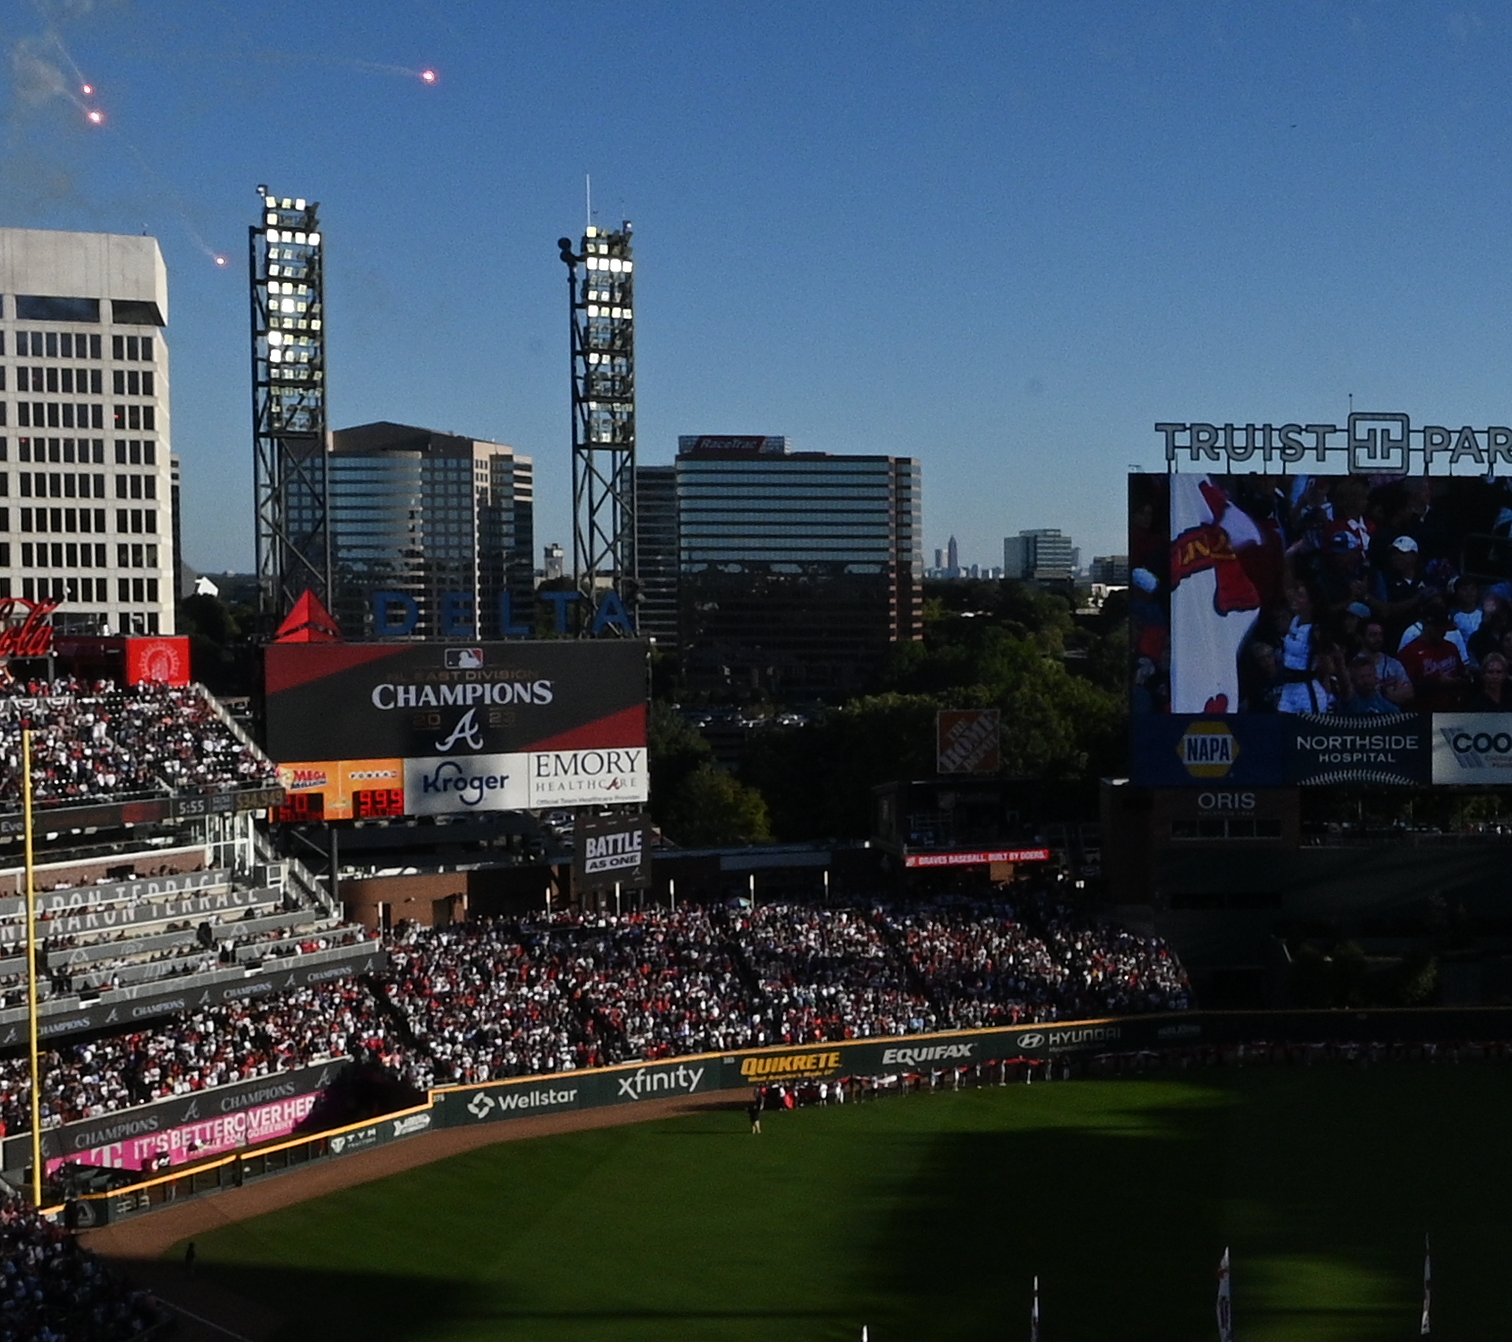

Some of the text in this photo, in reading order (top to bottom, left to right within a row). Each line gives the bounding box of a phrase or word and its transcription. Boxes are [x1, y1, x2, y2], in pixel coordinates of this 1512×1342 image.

[1155, 423, 1336, 462] TRUIST
[373, 590, 636, 637] DELTA
[465, 668, 539, 680] DIVISION
[372, 680, 553, 710] CHAMPIONS
[1188, 738, 1229, 762] NAPA
[1297, 735, 1419, 750] NORTHSIDE
[535, 750, 641, 778] EMORY
[1319, 753, 1395, 763] HOSPITAL
[295, 770, 326, 781] MEGA
[423, 762, 509, 805] Kroger
[536, 777, 637, 792] HEALTHCARE
[179, 799, 205, 815] 5:55
[1198, 792, 1256, 810] ORIS
[586, 830, 642, 858] BATTLE
[589, 854, 639, 870] AS ONE
[49, 905, 136, 935] AARON
[132, 997, 185, 1019] CHAMPIONS
[223, 980, 273, 1000] CHAMPIONS
[307, 965, 353, 984] CHAMPIONS
[1049, 1027, 1121, 1046] HYUNDAI
[741, 1052, 841, 1076] QUIKRETE
[882, 1043, 974, 1066] EQUIFAX
[618, 1064, 705, 1100] xfinity
[499, 1088, 578, 1111] Wellstar
[75, 1116, 159, 1149] CHAMPIONS
[221, 1081, 296, 1112] CHAMPIONS
[171, 1119, 236, 1150] BETTER
[234, 1105, 282, 1132] OVER
[347, 1128, 377, 1142] TYM
